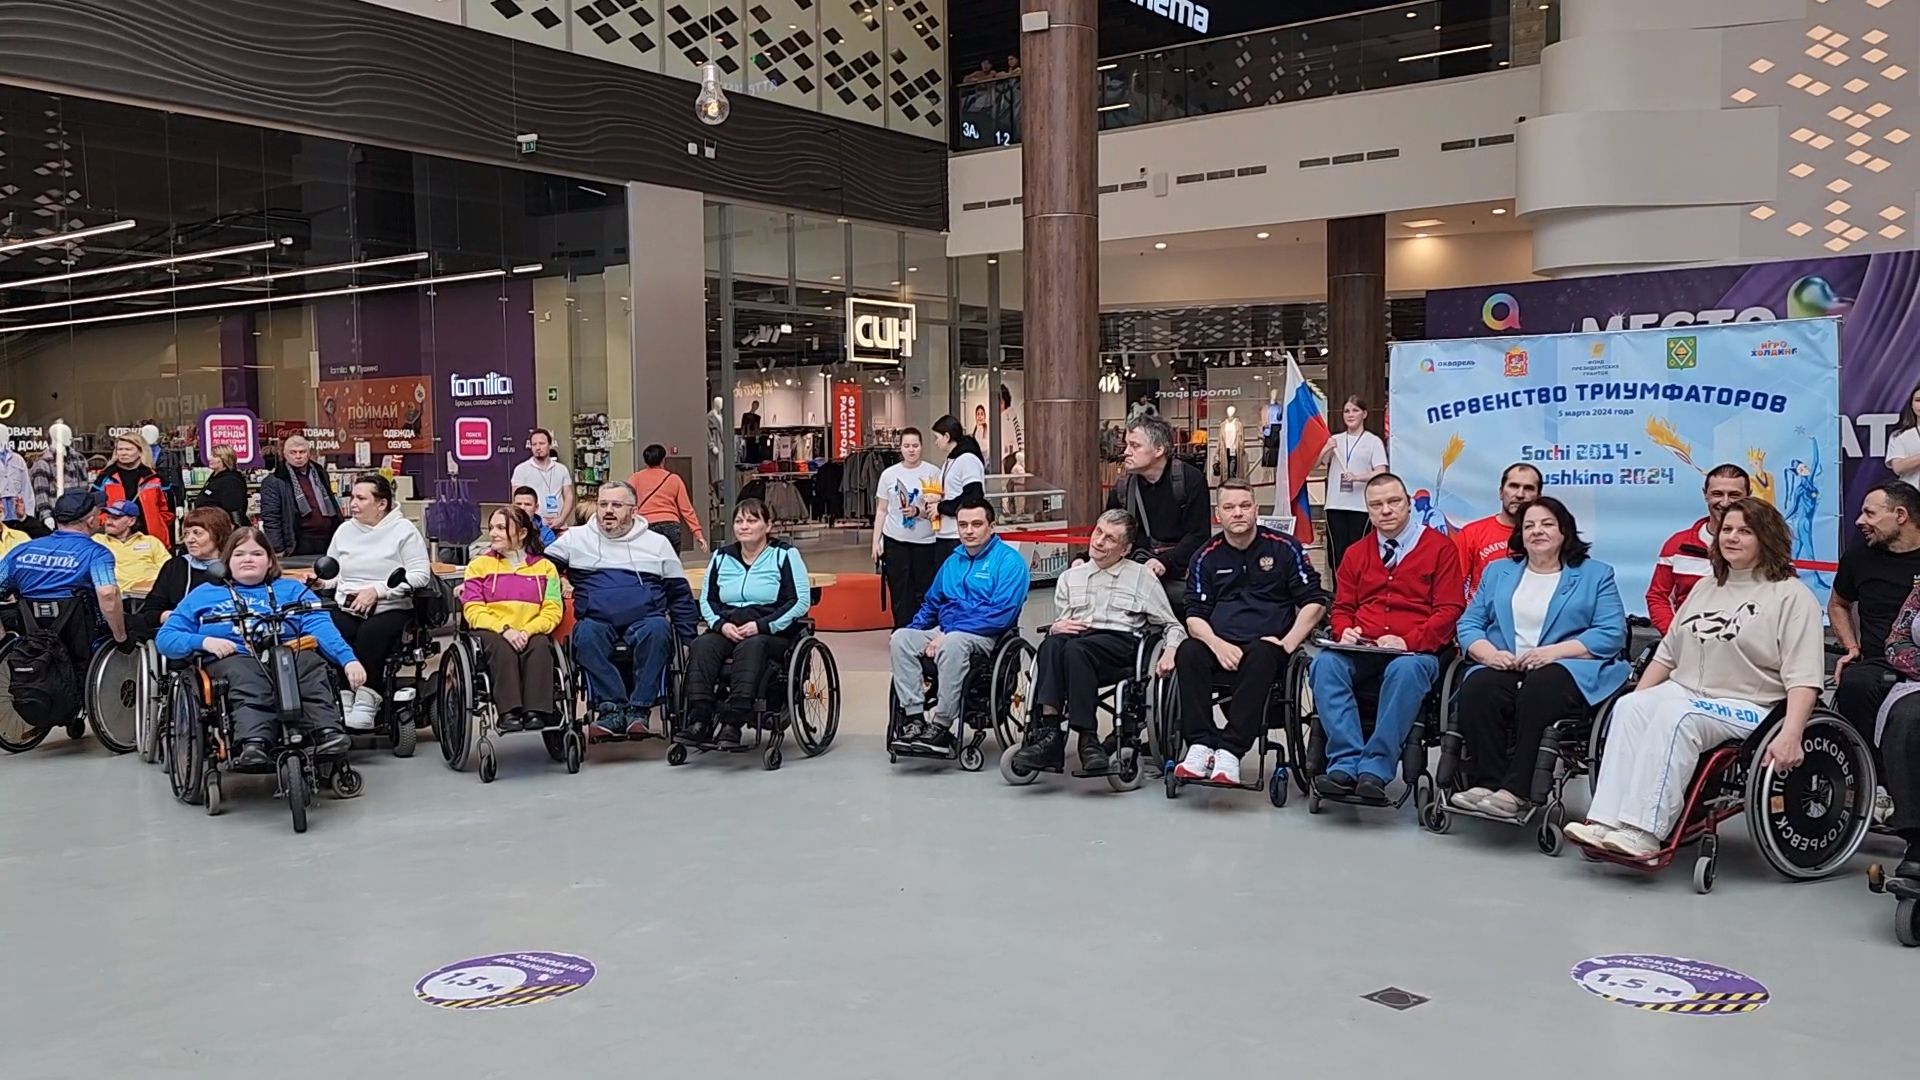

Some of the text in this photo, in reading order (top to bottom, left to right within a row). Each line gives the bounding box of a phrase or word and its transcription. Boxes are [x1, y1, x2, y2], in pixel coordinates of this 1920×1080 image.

[450, 371, 513, 397] familia
[348, 401, 398, 419] ПОЙМАЙ
[1427, 381, 1788, 424] ПЕРВЕНСТВО ТРИУМФАТОРОВ
[848, 396, 856, 447] ФИНАЛ
[1558, 408, 1634, 418] 5 марта 2024 года
[7, 427, 43, 437] ОВАРЫ
[213, 431, 246, 439] БРЕНДЫ
[302, 428, 335, 438] ТОВАРЫ
[383, 429, 415, 439] ОДЕЖДА
[839, 395, 848, 458] РАСПРОД
[17, 440, 50, 452] ДОМА
[315, 440, 340, 451] ДОМА
[387, 440, 412, 450] ОБУВЬ
[1521, 444, 1571, 461] Sochi
[1576, 443, 1629, 460] 2014
[1542, 467, 1674, 486] ushkino 2024
[1736, 709, 1760, 724] 201
[1771, 737, 1854, 793] ПООСКОВЬЕ
[1775, 809, 1850, 852] ЕГОРЬЕВСК
[1597, 973, 1648, 990] 1,5
